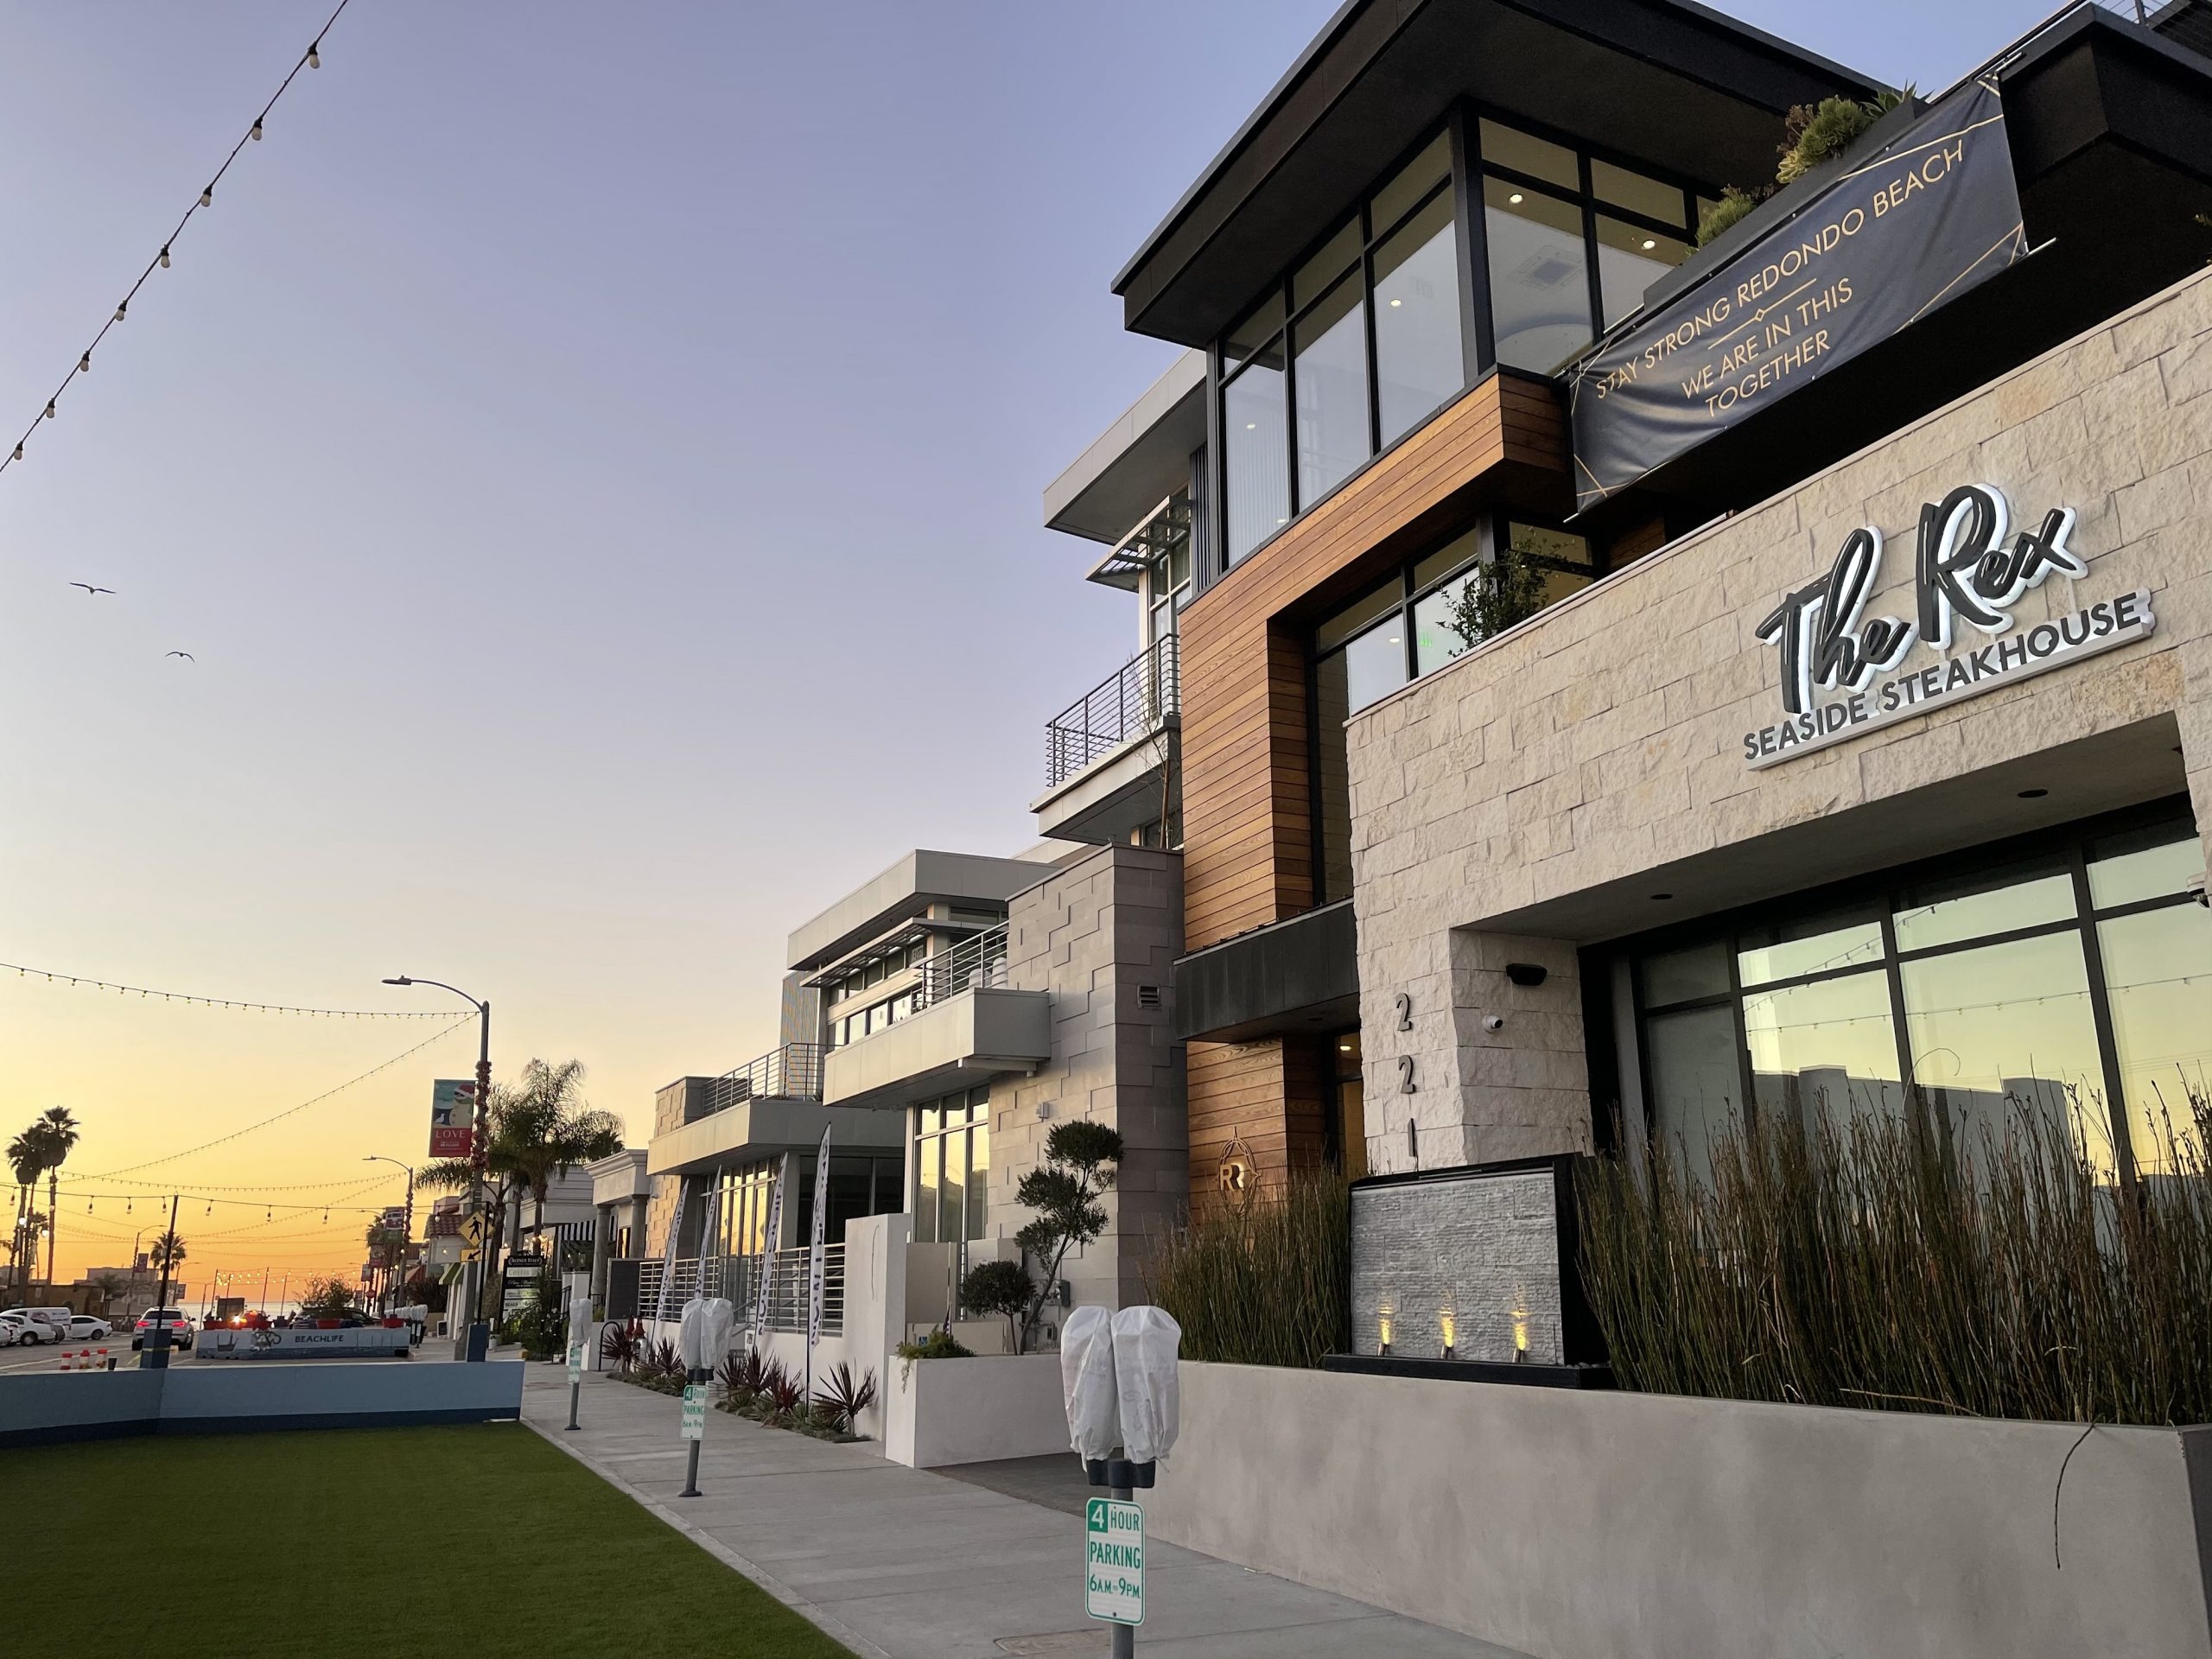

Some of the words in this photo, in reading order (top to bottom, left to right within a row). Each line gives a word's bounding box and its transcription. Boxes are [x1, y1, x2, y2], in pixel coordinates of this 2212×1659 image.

[1597, 355, 1639, 400] STAY
[1644, 296, 1732, 371] STRONG
[1736, 207, 1866, 309] REDONDO
[1872, 138, 1965, 219] BEACH
[1681, 367, 1714, 400] WE
[1719, 339, 1760, 380] ARE
[1764, 315, 1792, 349] IN
[1796, 276, 1854, 327] THIS
[1704, 328, 1832, 418] TOGETHER
[1755, 525, 1916, 715] The
[1915, 484, 2084, 646] Rex
[1743, 691, 1870, 760] SEASIDE
[1883, 591, 2145, 712] STEAKHOUSE
[435, 1129, 467, 1139] LOVE
[295, 1334, 345, 1343] BEACHLIFE
[685, 1387, 692, 1400] 4
[683, 1405, 705, 1416] PARKING
[1090, 1503, 1105, 1529] 4
[1110, 1510, 1141, 1532] HOUR
[1090, 1541, 1141, 1570] PARKING
